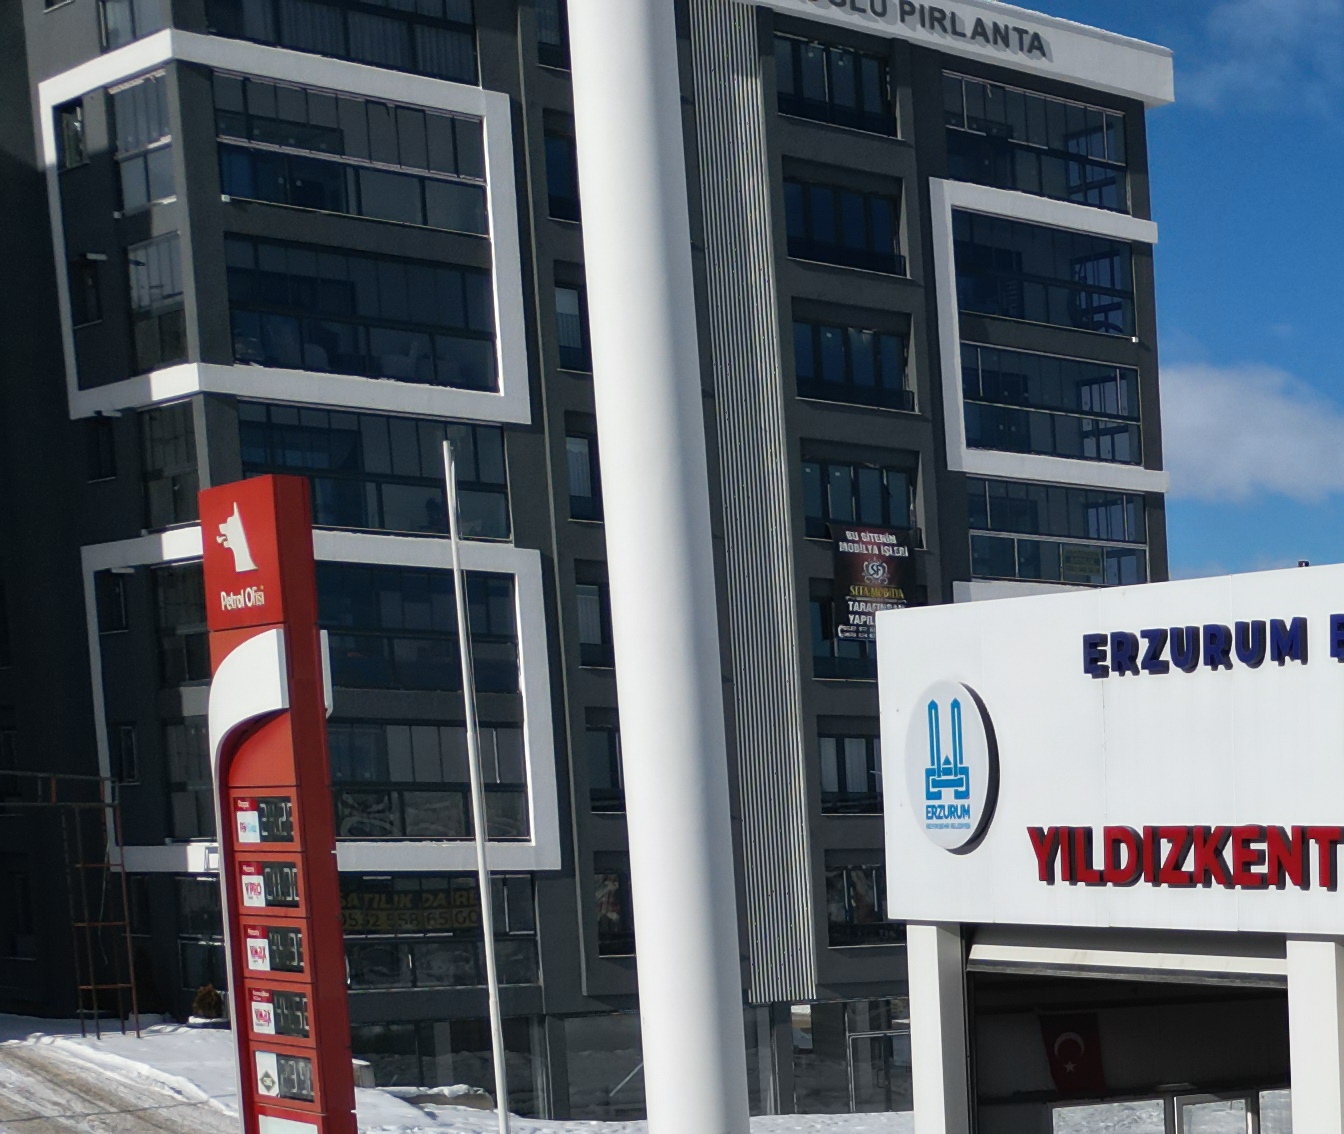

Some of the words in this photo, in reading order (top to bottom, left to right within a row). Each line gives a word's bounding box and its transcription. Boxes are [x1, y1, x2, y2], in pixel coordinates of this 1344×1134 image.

[899, 0, 1047, 58] PIRLANTA
[839, 541, 879, 555] MOBİLYA
[220, 588, 245, 611] Petrol
[1083, 616, 1308, 679] ERZURUM
[926, 804, 971, 820] ERZURUM
